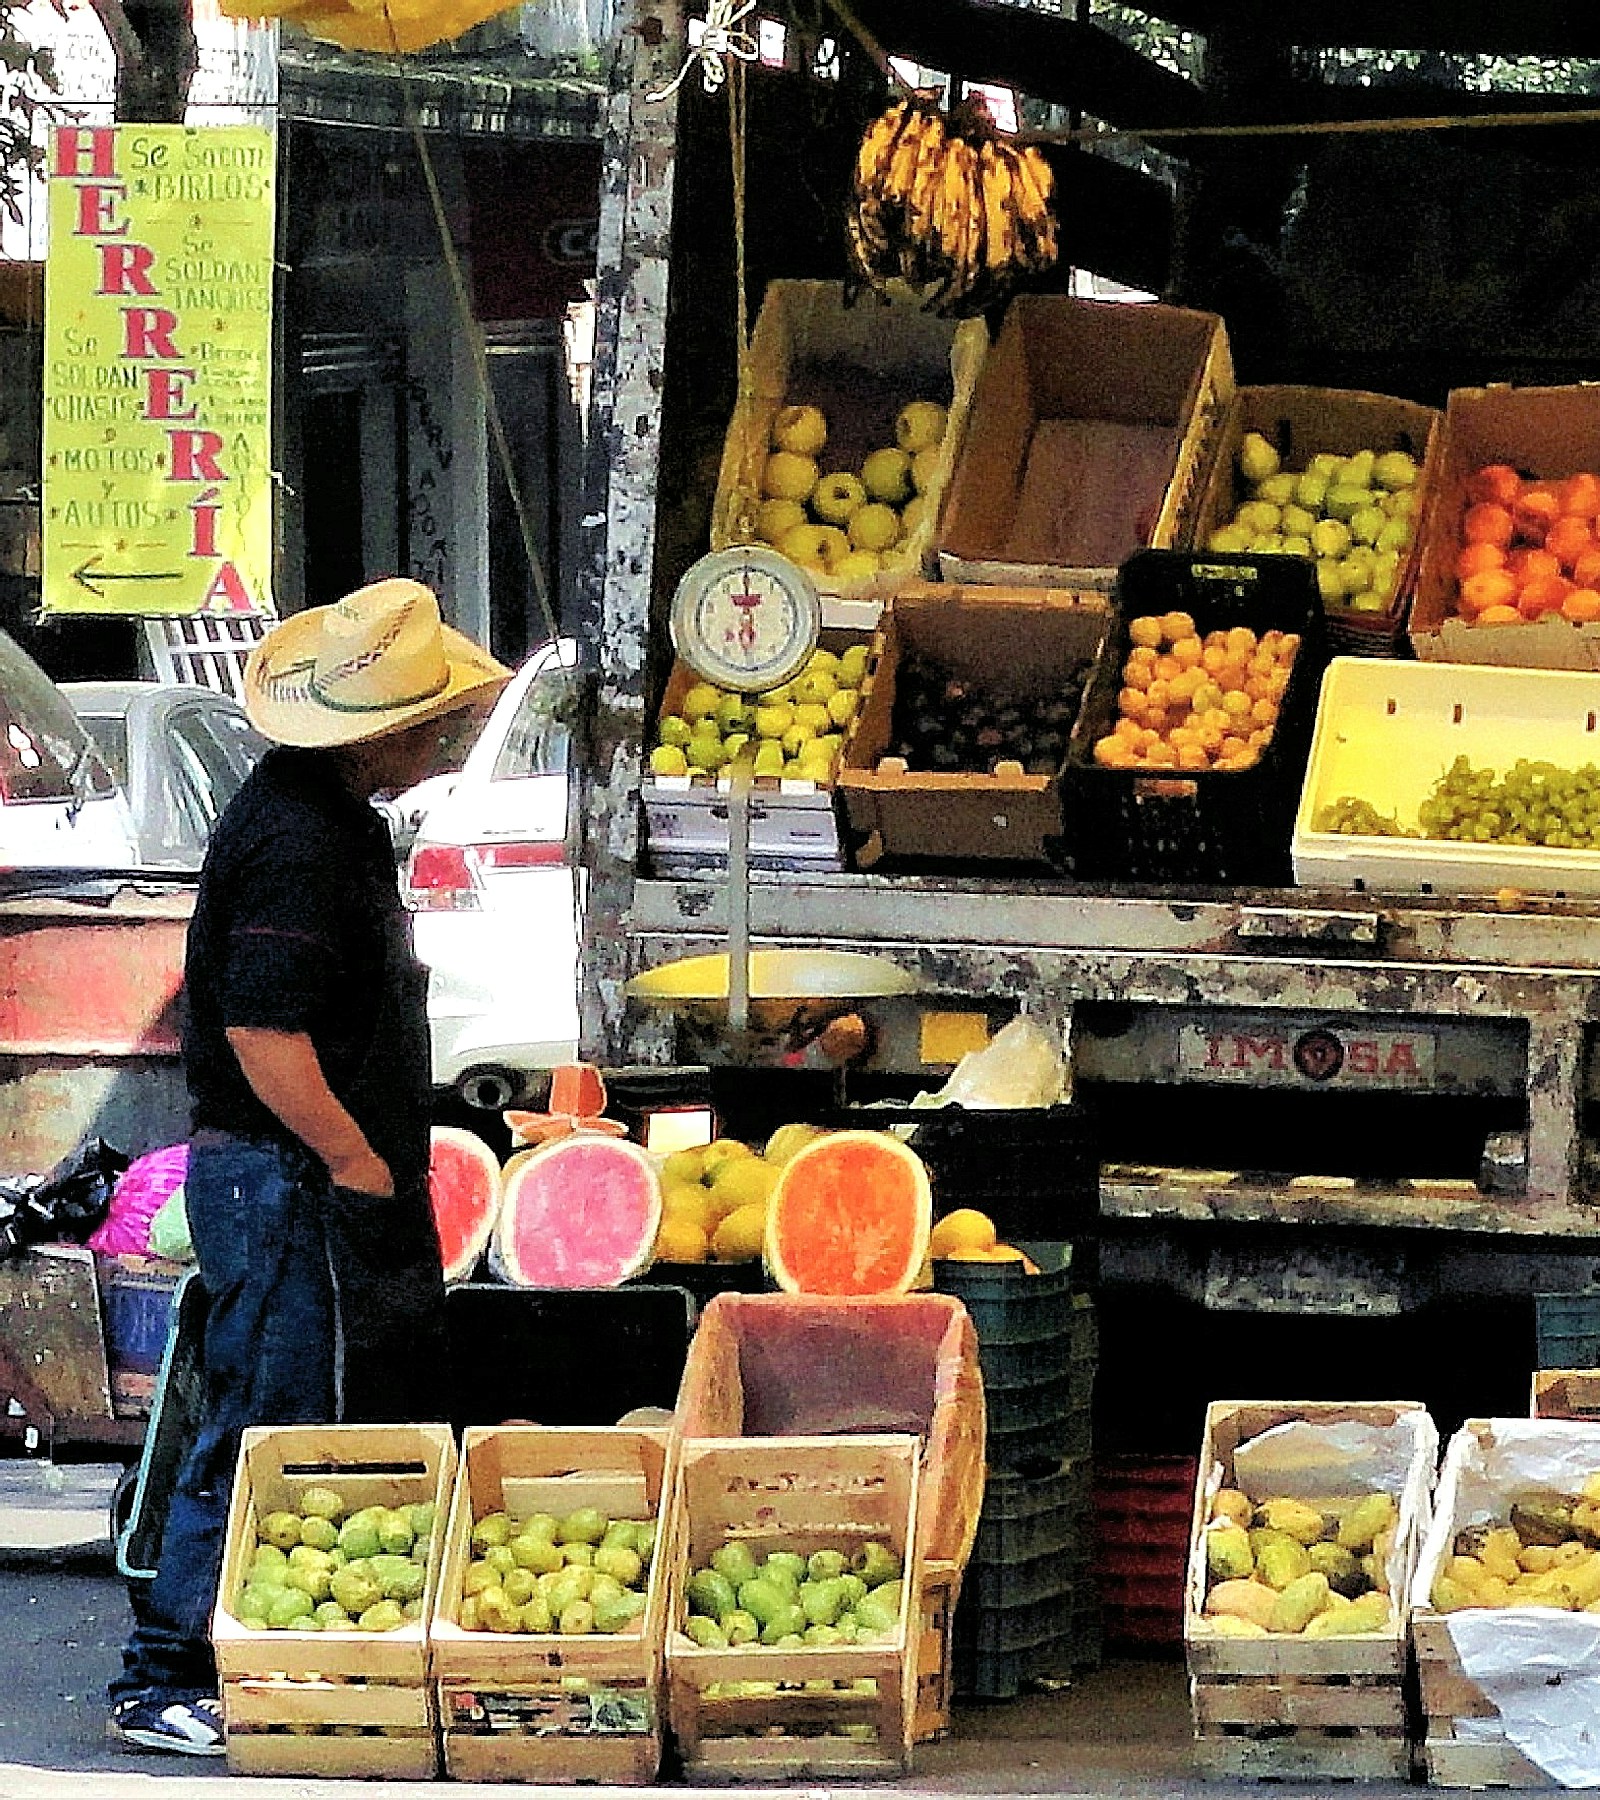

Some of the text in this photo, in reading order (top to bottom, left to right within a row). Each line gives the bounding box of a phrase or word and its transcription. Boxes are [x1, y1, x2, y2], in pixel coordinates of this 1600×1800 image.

[131, 137, 169, 169] Se
[153, 173, 263, 202] BIRLOS
[166, 258, 260, 284] SOLDAN
[64, 327, 98, 357] Se
[50, 125, 257, 611] HERRERÍA
[53, 363, 138, 390] SOLDAN
[65, 449, 153, 472] MOTOS
[65, 500, 160, 528] AUTOS
